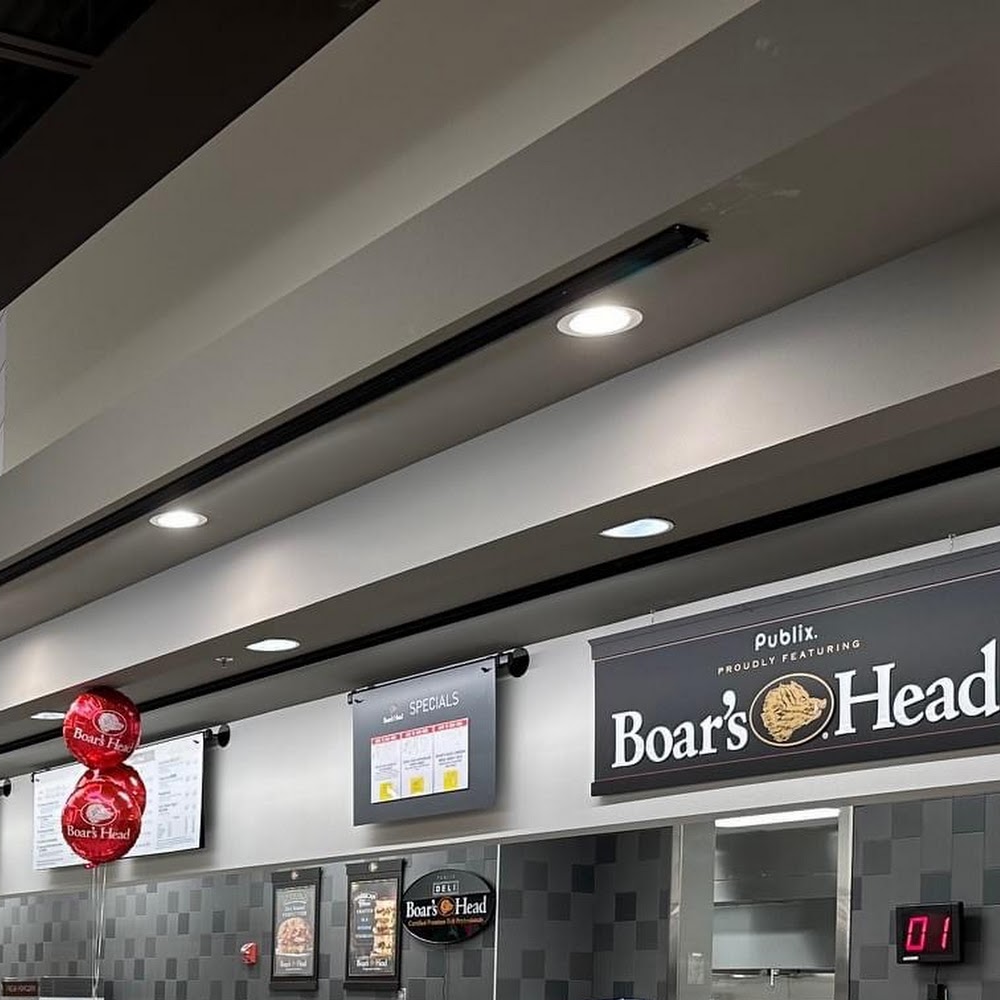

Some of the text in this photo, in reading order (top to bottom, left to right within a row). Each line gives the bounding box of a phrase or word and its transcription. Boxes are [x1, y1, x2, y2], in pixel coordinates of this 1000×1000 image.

[717, 639, 862, 676] PROUDLY FEATURING
[409, 691, 460, 715] SPECIALS
[611, 638, 1000, 769] Boar's Head
[73, 727, 134, 753] Boar's Head
[67, 825, 130, 840] Boar's Head
[435, 884, 456, 892] DELI
[406, 895, 487, 918] Boar's Head
[904, 915, 950, 952] 01
